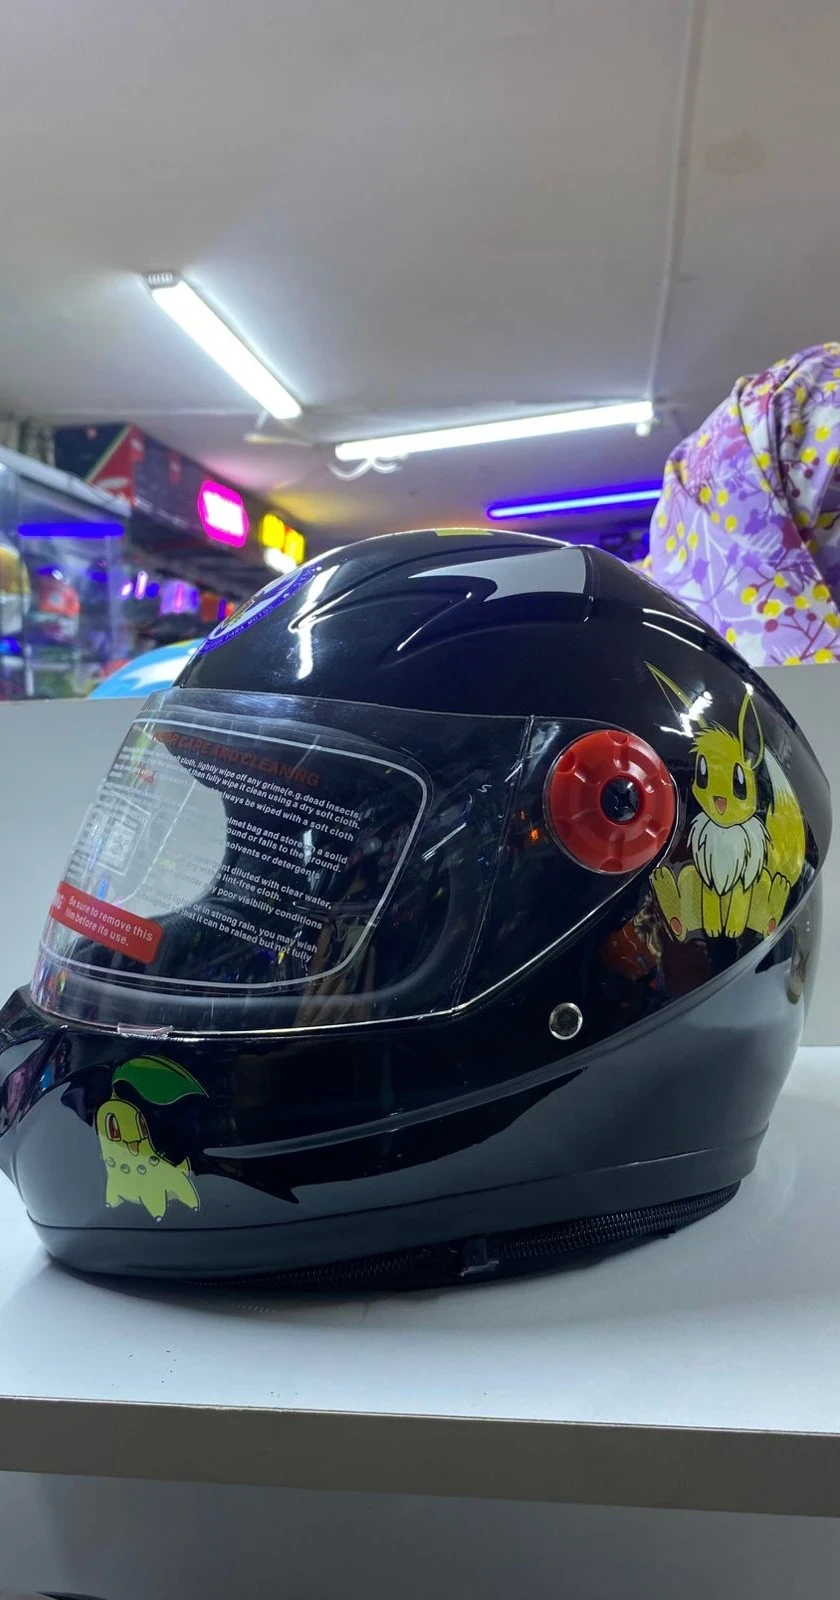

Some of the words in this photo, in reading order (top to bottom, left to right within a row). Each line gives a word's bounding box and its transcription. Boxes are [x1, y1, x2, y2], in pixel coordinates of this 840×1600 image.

[180, 757, 197, 767] cloth,
[197, 760, 219, 773] lightly
[219, 768, 236, 778] wipe
[236, 773, 248, 782] off
[247, 777, 261, 787] any
[325, 801, 361, 821] insects,
[238, 753, 320, 787] CLEANING
[205, 773, 221, 785] fully
[221, 779, 239, 789] wipe
[239, 783, 246, 791] it
[246, 786, 268, 798] clean
[268, 792, 292, 808] using
[299, 803, 314, 814] dry
[315, 809, 334, 820] soft
[335, 815, 360, 829] cloth.
[245, 798, 255, 808] be
[256, 803, 282, 816] wiped
[283, 811, 301, 823] with
[310, 821, 328, 832] soft
[329, 829, 354, 842] cloth
[226, 841, 260, 858] solvents
[261, 854, 271, 862] or
[271, 856, 321, 879] detergents
[246, 823, 262, 836] bag
[263, 830, 280, 840] and
[280, 835, 303, 848] store
[317, 848, 323, 856] a
[324, 852, 348, 864] solid
[248, 835, 258, 843] or
[258, 837, 278, 849] falls
[279, 844, 288, 853] to
[289, 848, 304, 859] the
[222, 873, 256, 892] lint-free
[256, 887, 281, 901] cloth.
[230, 866, 260, 883] diluted
[261, 878, 279, 890] with
[280, 885, 304, 899] clear
[304, 893, 332, 910] water,
[68, 895, 77, 905] Be
[76, 901, 90, 913] sure
[90, 907, 98, 917] to
[98, 912, 132, 932] remove
[132, 925, 153, 941] this
[75, 912, 97, 931] before
[97, 925, 109, 936] its
[109, 931, 129, 946] use.
[193, 904, 202, 912] or
[202, 905, 210, 915] in
[210, 910, 238, 925] strong
[238, 921, 257, 934] rain,
[259, 928, 275, 939] you
[276, 934, 296, 946] may
[297, 940, 318, 953] wish
[216, 888, 238, 900] poor
[238, 895, 275, 914] visibility
[275, 909, 323, 929] conditions
[180, 909, 196, 920] that
[196, 914, 203, 923] it
[203, 918, 218, 929] can
[218, 923, 230, 933] be
[230, 928, 258, 943] raised
[258, 938, 275, 949] but
[274, 944, 290, 954] not
[291, 947, 312, 962] fully
